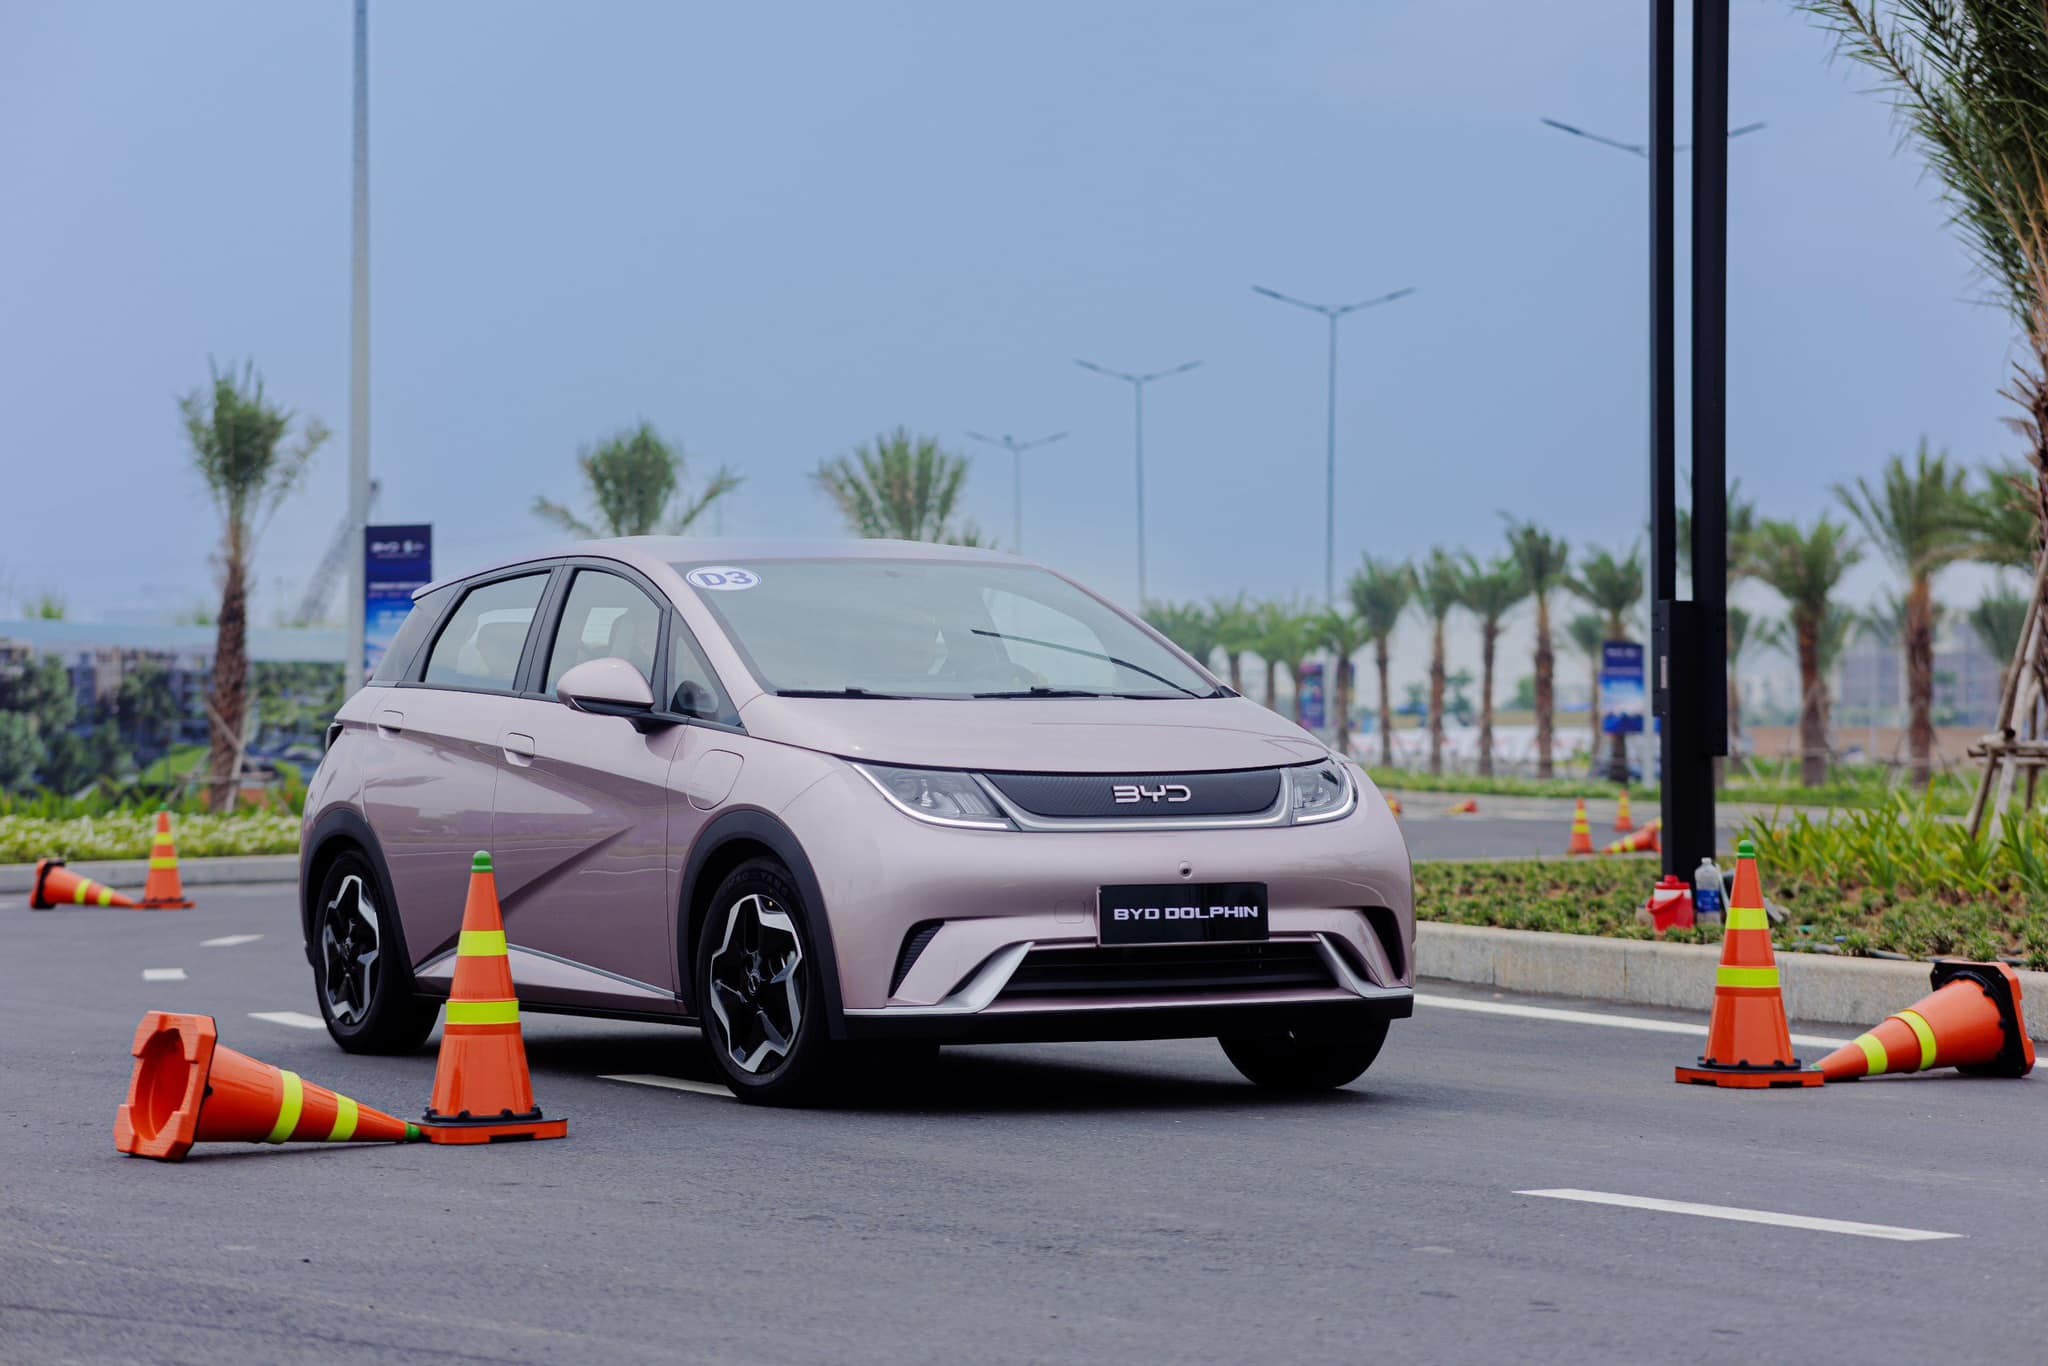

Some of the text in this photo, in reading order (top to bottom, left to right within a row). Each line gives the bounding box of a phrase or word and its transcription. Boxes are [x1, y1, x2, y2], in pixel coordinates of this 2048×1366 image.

[698, 571, 752, 586] D3
[1112, 784, 1192, 803] BYD
[1113, 905, 1259, 920] BYD DOLPHIN
